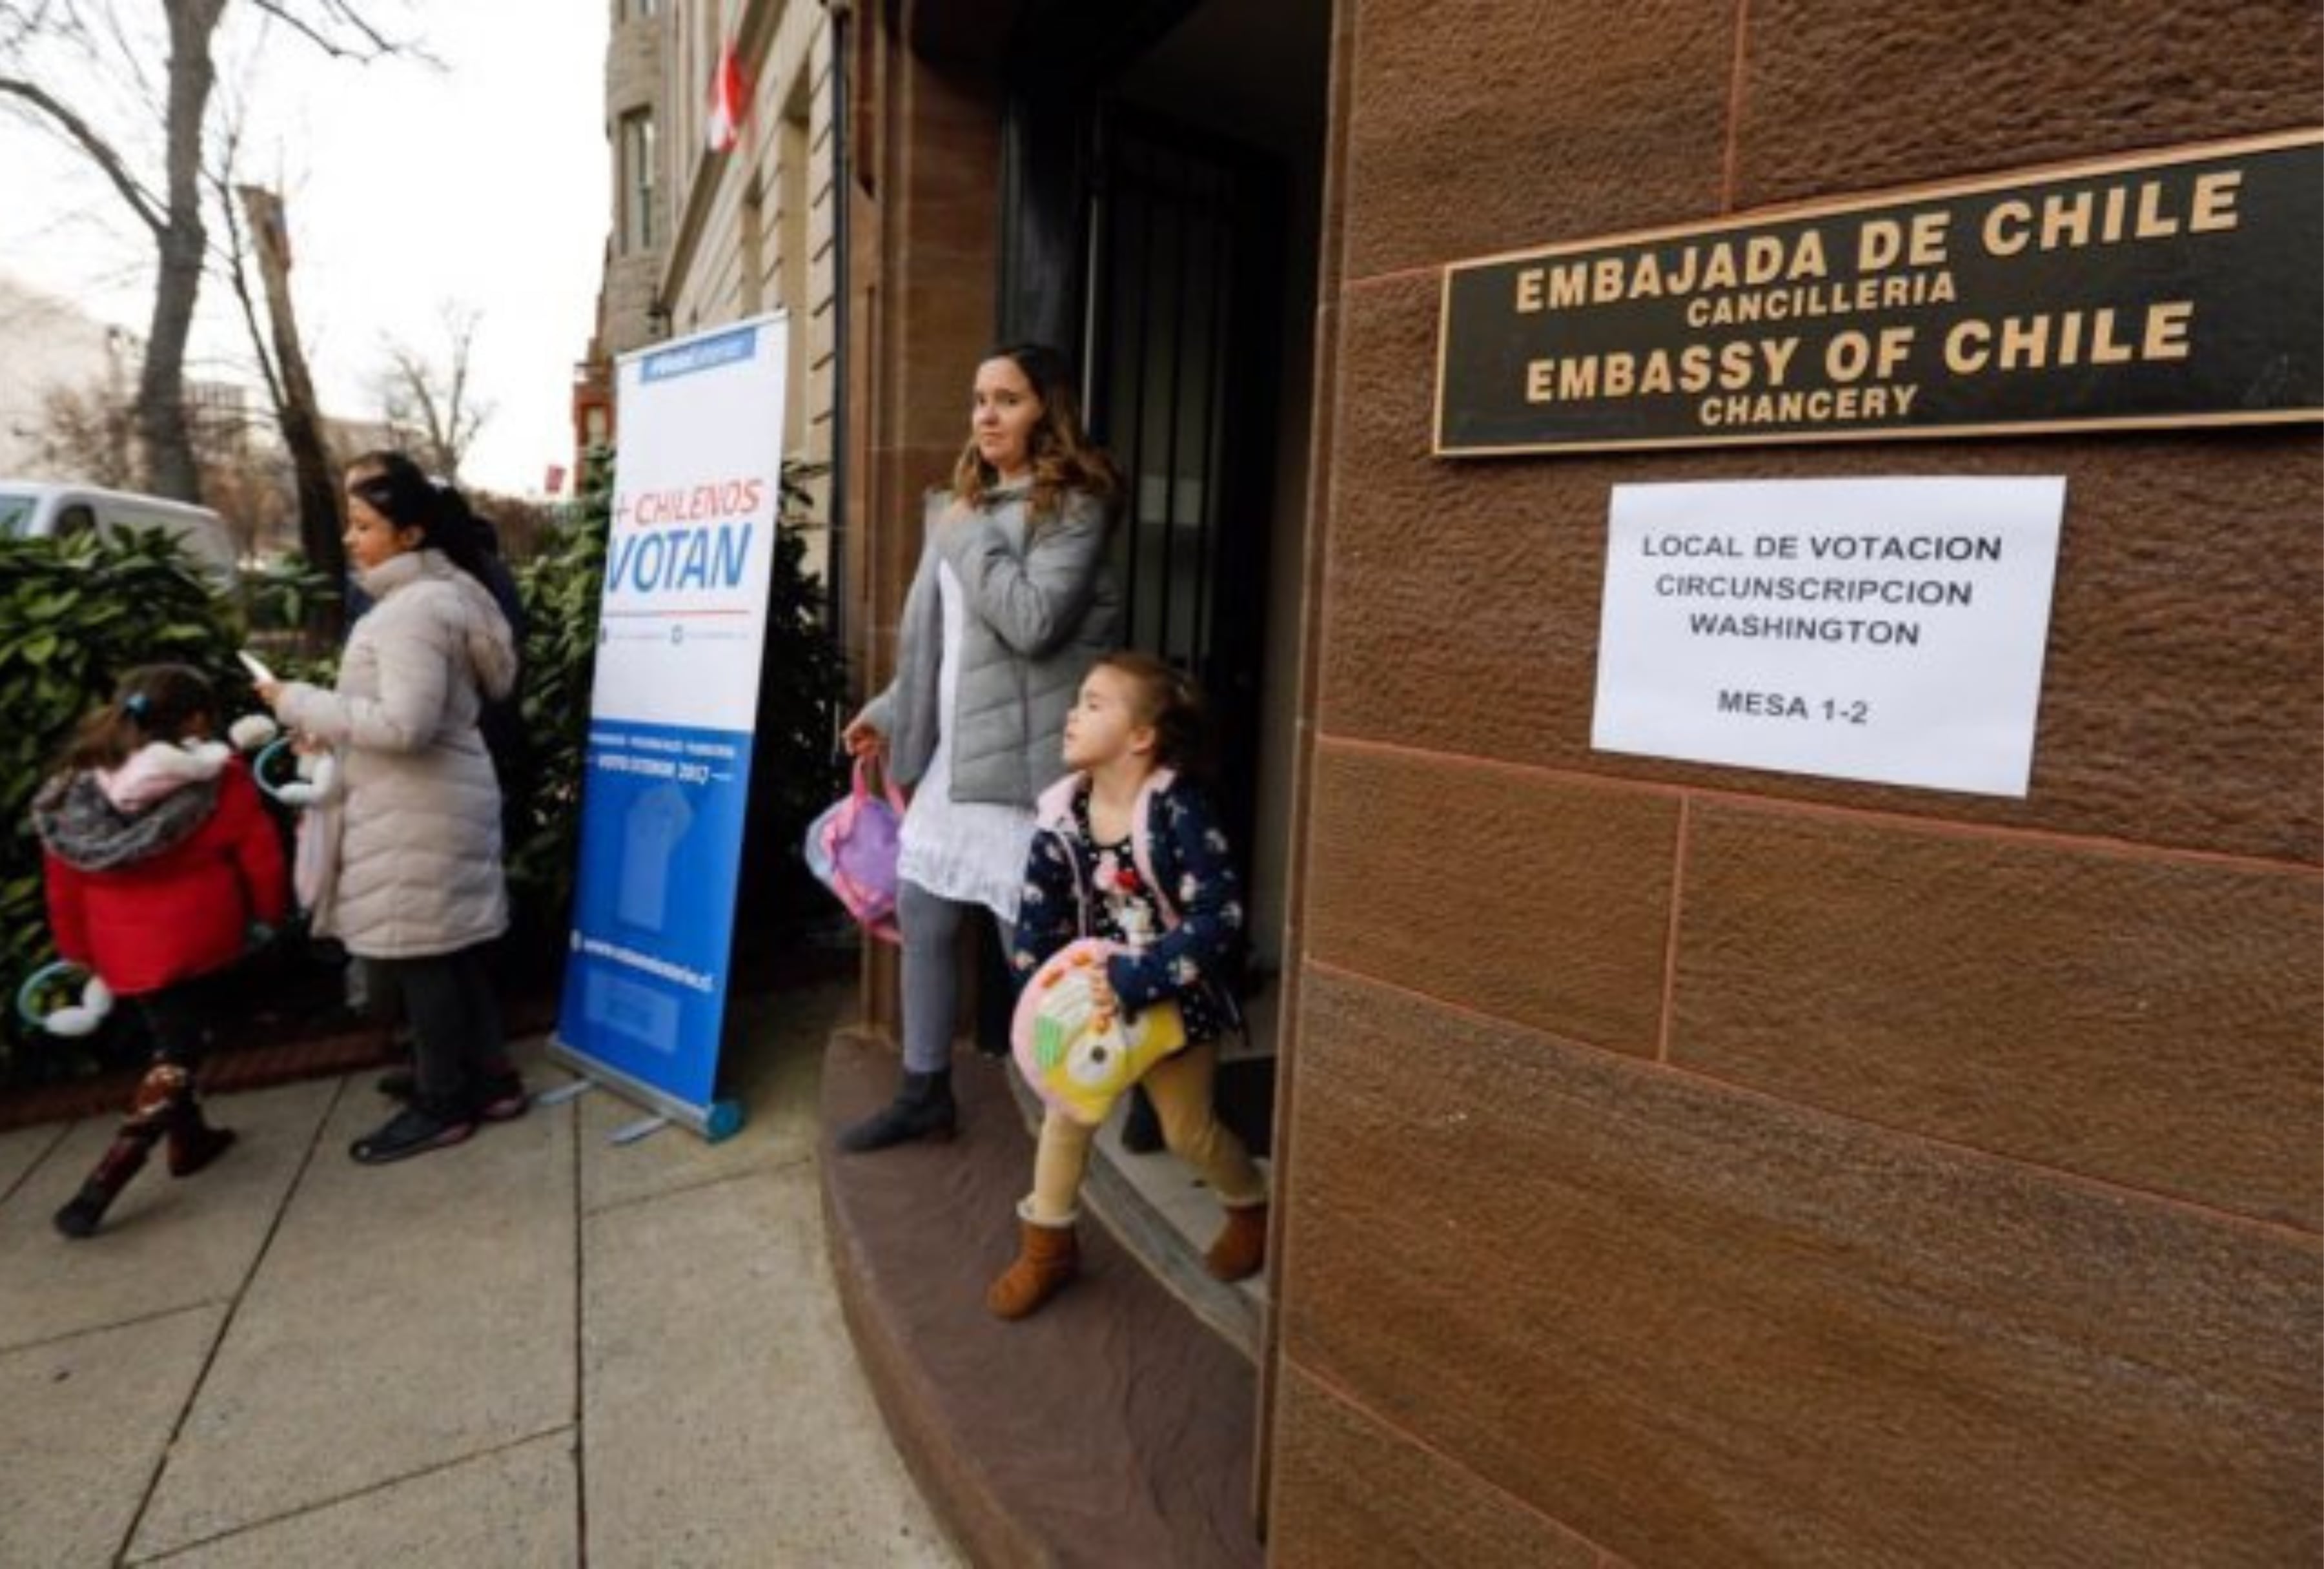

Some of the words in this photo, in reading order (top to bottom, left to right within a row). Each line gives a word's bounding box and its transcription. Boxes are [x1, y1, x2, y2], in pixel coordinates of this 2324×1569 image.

[1515, 229, 1828, 313] EMBAJADA
[1857, 211, 1952, 272] DE
[1981, 170, 2243, 256] CHILE
[1686, 271, 1956, 328] CANCILLERIA
[1525, 337, 1799, 403] EMBASSY
[1825, 327, 1915, 382] OF
[1944, 302, 2193, 374] CHILE
[1699, 385, 1917, 426] CHANCERY
[635, 478, 764, 527] CHILENOS
[608, 522, 753, 593] VOTAN
[1642, 534, 1744, 558] LOCAL
[1753, 535, 1799, 560] DE
[1809, 535, 2003, 562] VOTACION
[1655, 573, 1973, 607] CIRCUNSCRIPCION
[1689, 613, 1921, 647] WASHINGTON
[1718, 689, 1809, 720] MESA
[1822, 699, 1869, 724] 1-2
